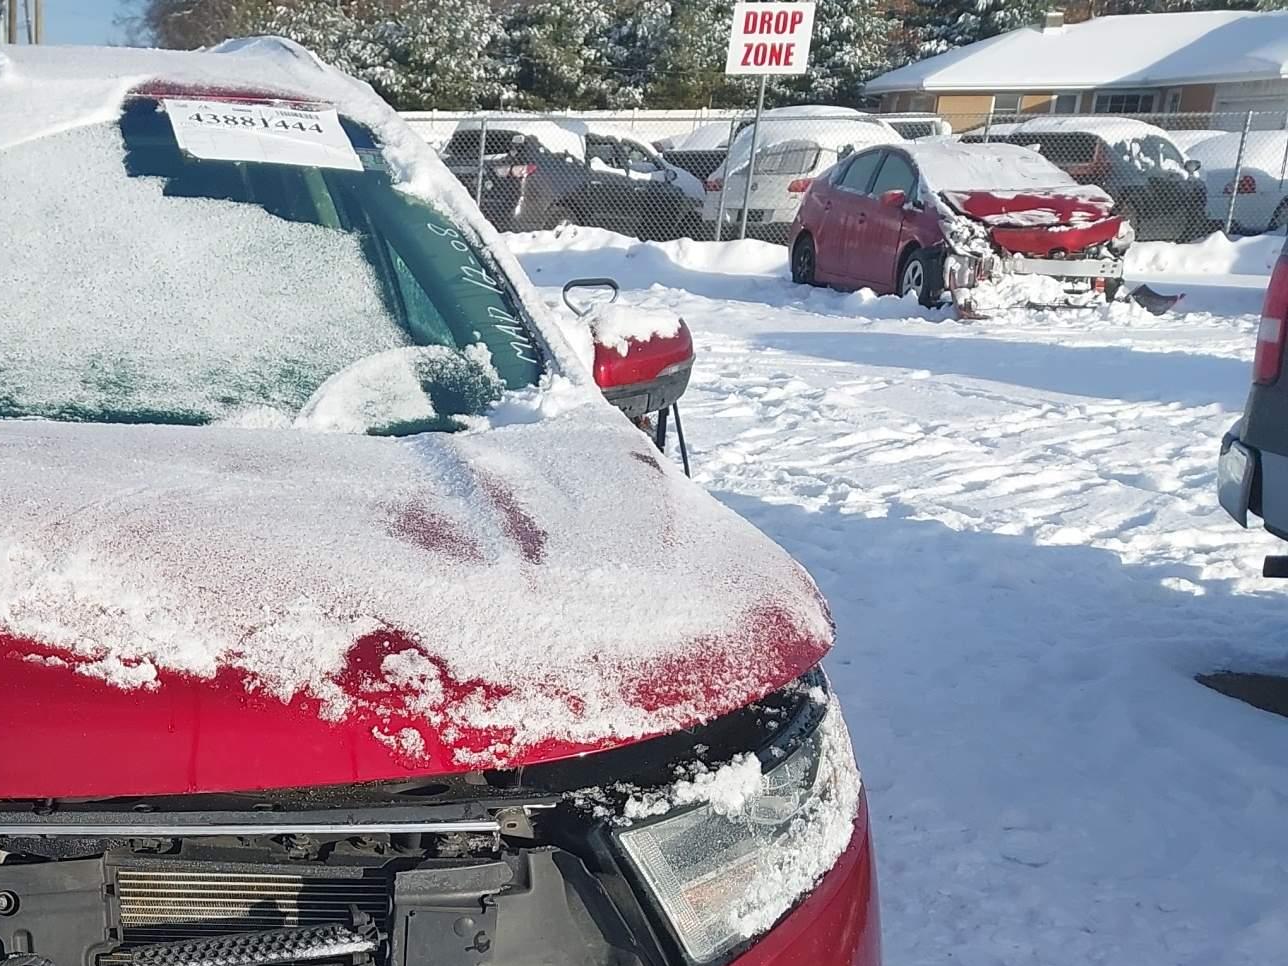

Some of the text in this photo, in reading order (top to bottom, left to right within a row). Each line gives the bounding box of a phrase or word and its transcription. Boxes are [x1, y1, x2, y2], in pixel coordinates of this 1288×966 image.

[743, 10, 804, 35] DROP
[740, 42, 796, 67] ZONE
[188, 112, 324, 134] 43881444
